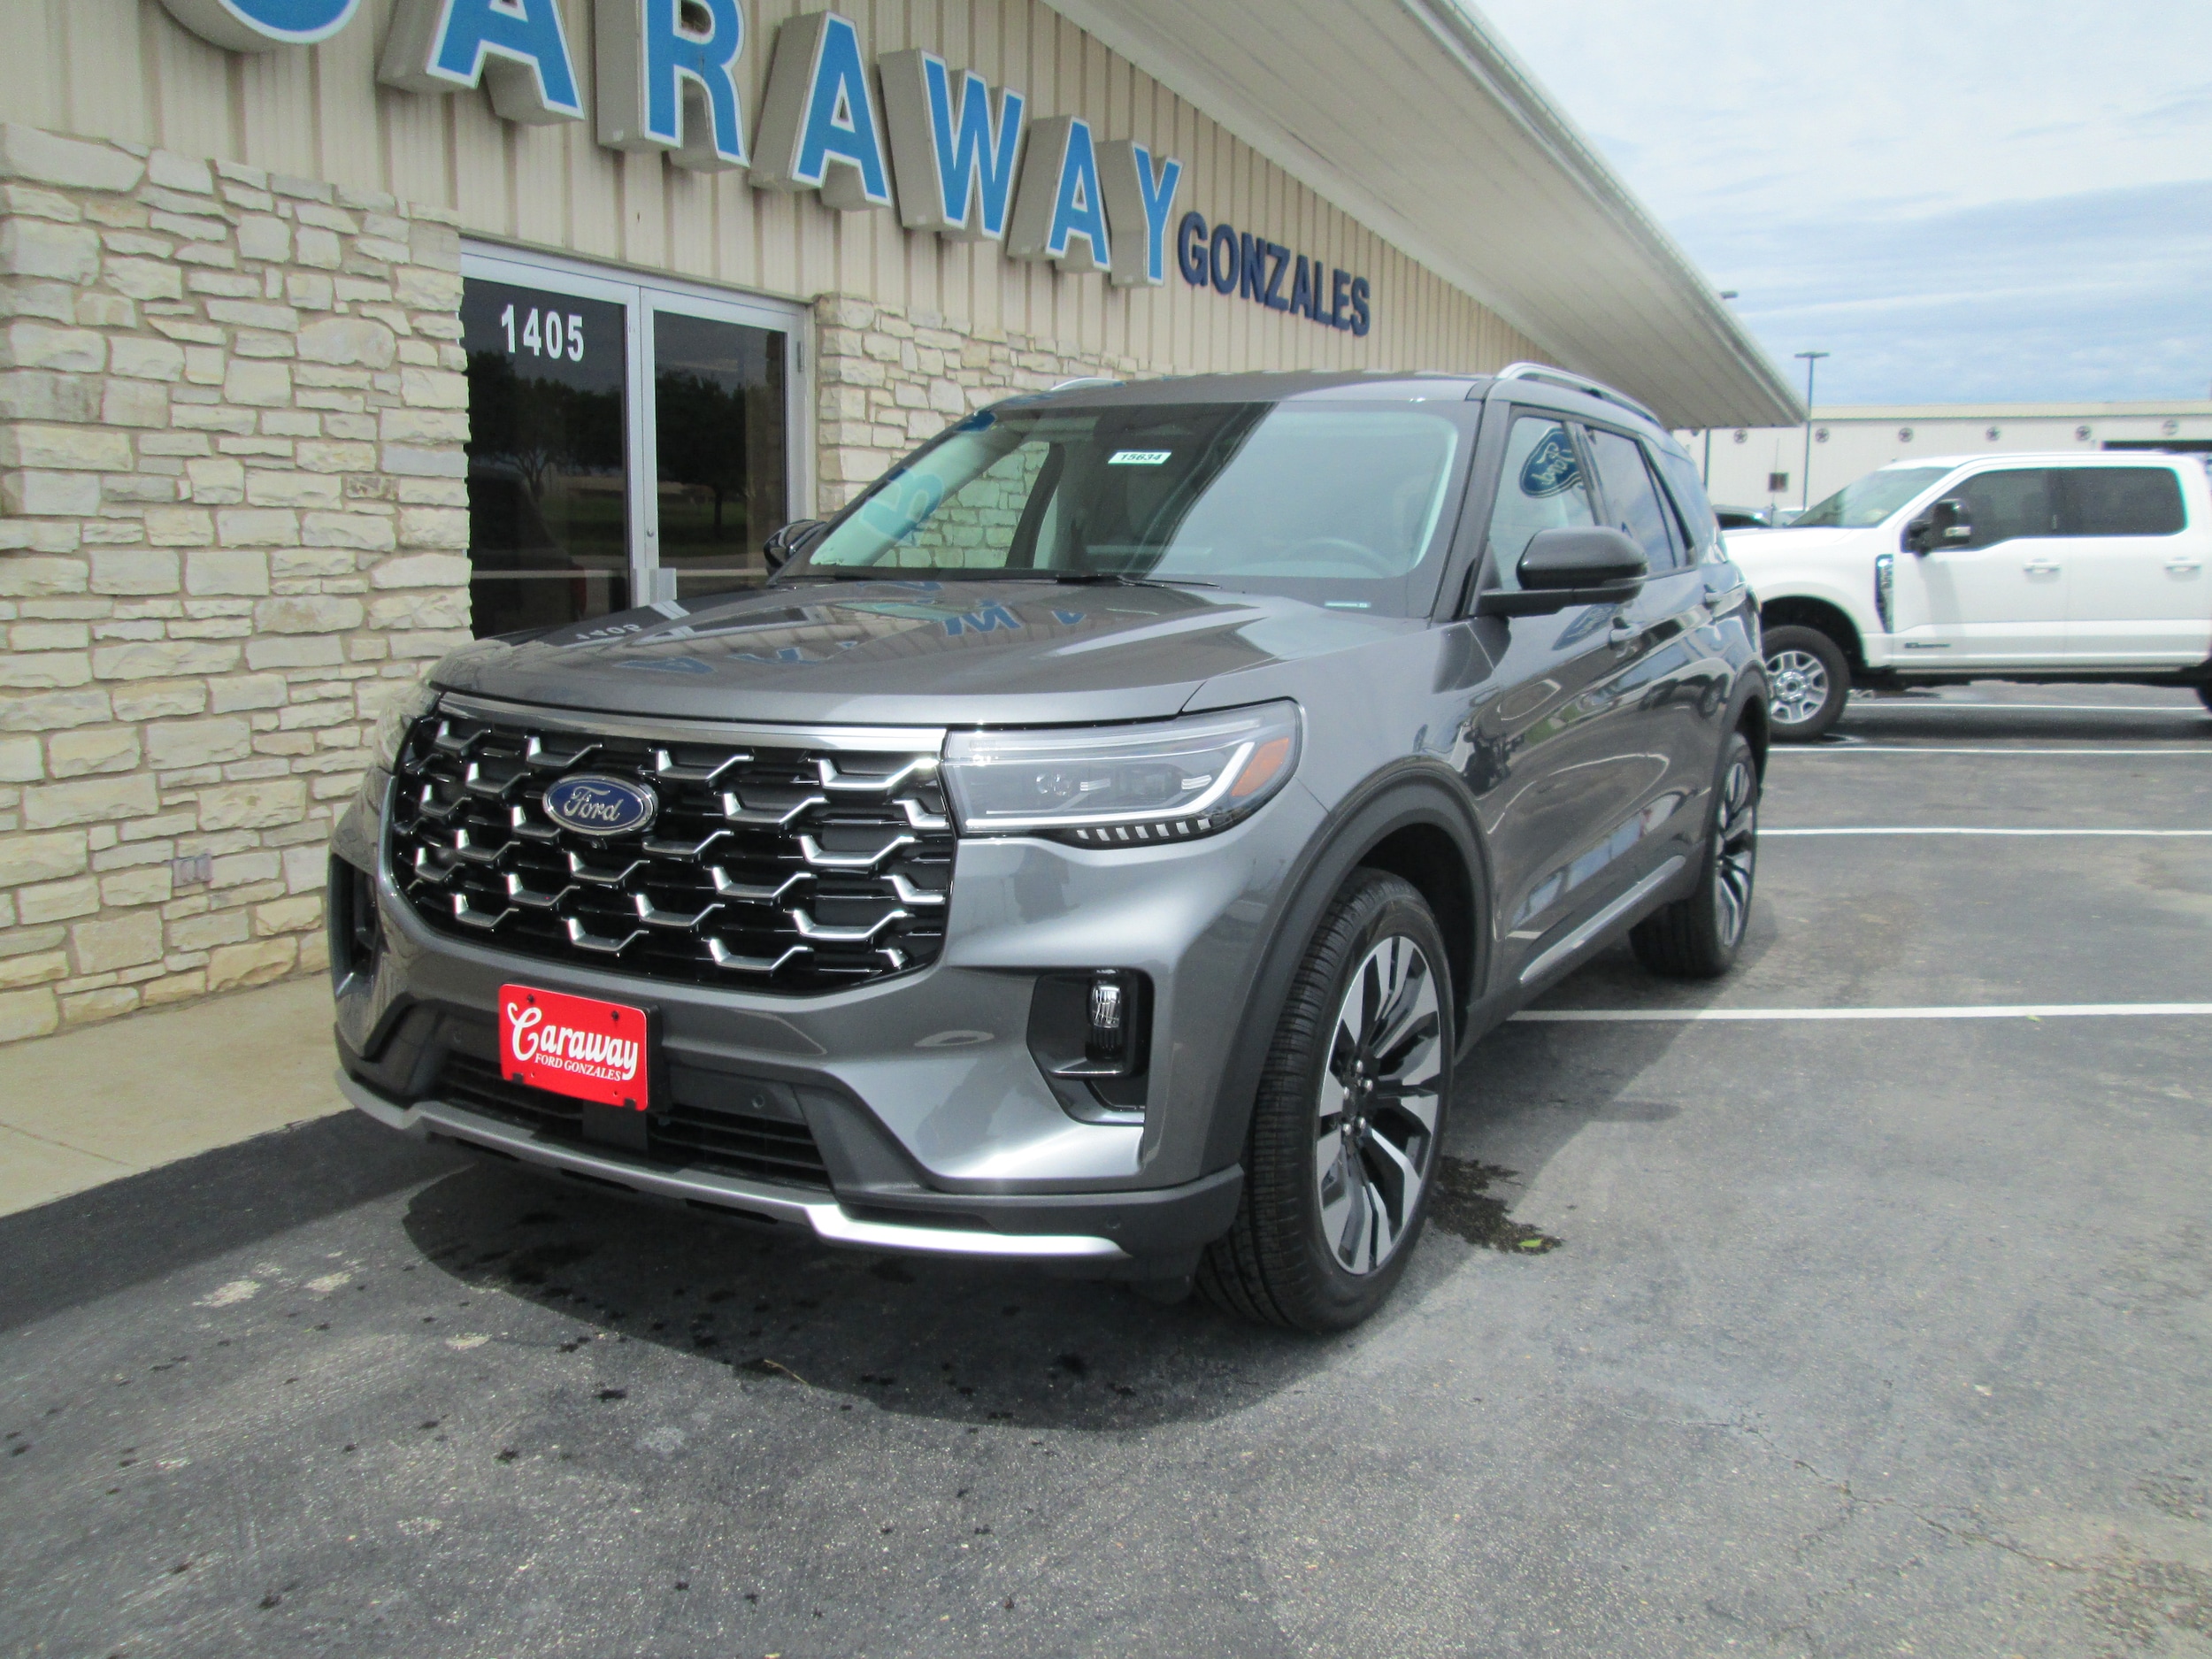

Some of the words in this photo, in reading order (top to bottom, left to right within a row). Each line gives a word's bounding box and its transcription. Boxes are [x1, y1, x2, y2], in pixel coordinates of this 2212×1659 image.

[223, 0, 1184, 287] ARAWAY
[1177, 211, 1371, 336] GONZALES
[500, 303, 585, 362] 1405
[564, 786, 624, 822] Ford
[506, 1002, 639, 1081] Caraway
[534, 1053, 563, 1069] FORD
[564, 1060, 622, 1082] GONZALES
